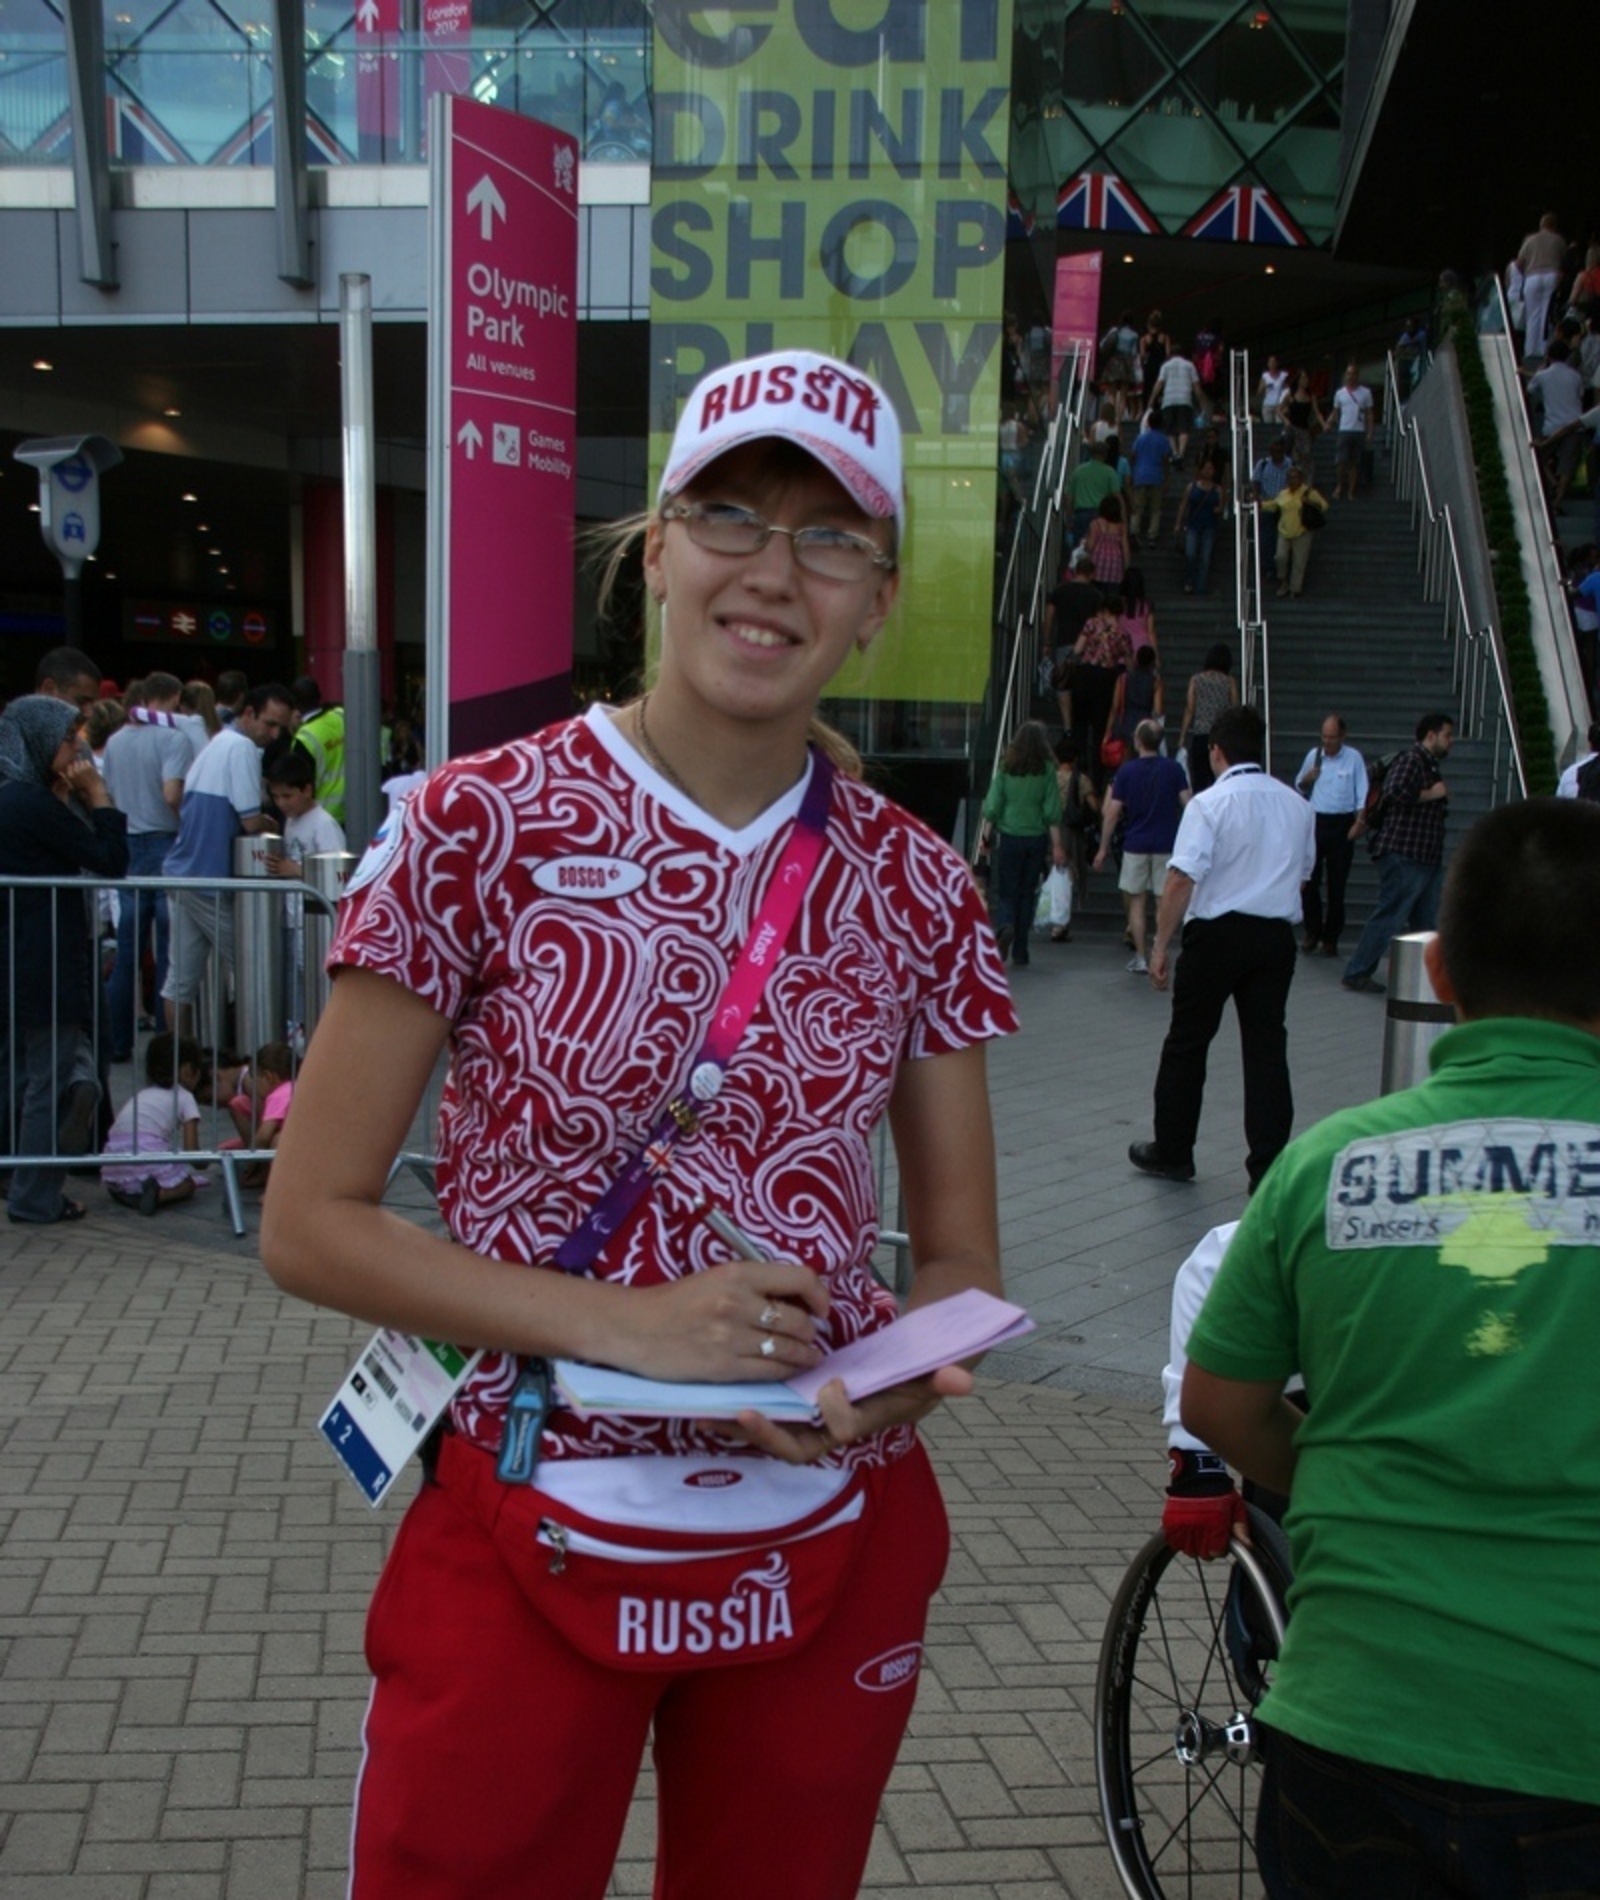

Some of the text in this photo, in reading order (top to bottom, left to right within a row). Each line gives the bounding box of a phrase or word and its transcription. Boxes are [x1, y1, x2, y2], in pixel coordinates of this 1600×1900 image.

[652, 87, 1010, 182] DRINK
[650, 198, 1005, 302] SHOP
[467, 263, 569, 319] Olympic
[467, 304, 525, 348] Park
[466, 352, 536, 382] All venues
[699, 364, 878, 449] RUSSIA
[528, 429, 566, 454] Games
[528, 451, 572, 480] Mobility
[558, 865, 607, 889] BOSCO
[1345, 1215, 1440, 1242] Sunsets
[618, 1588, 794, 1655] RUSSIA
